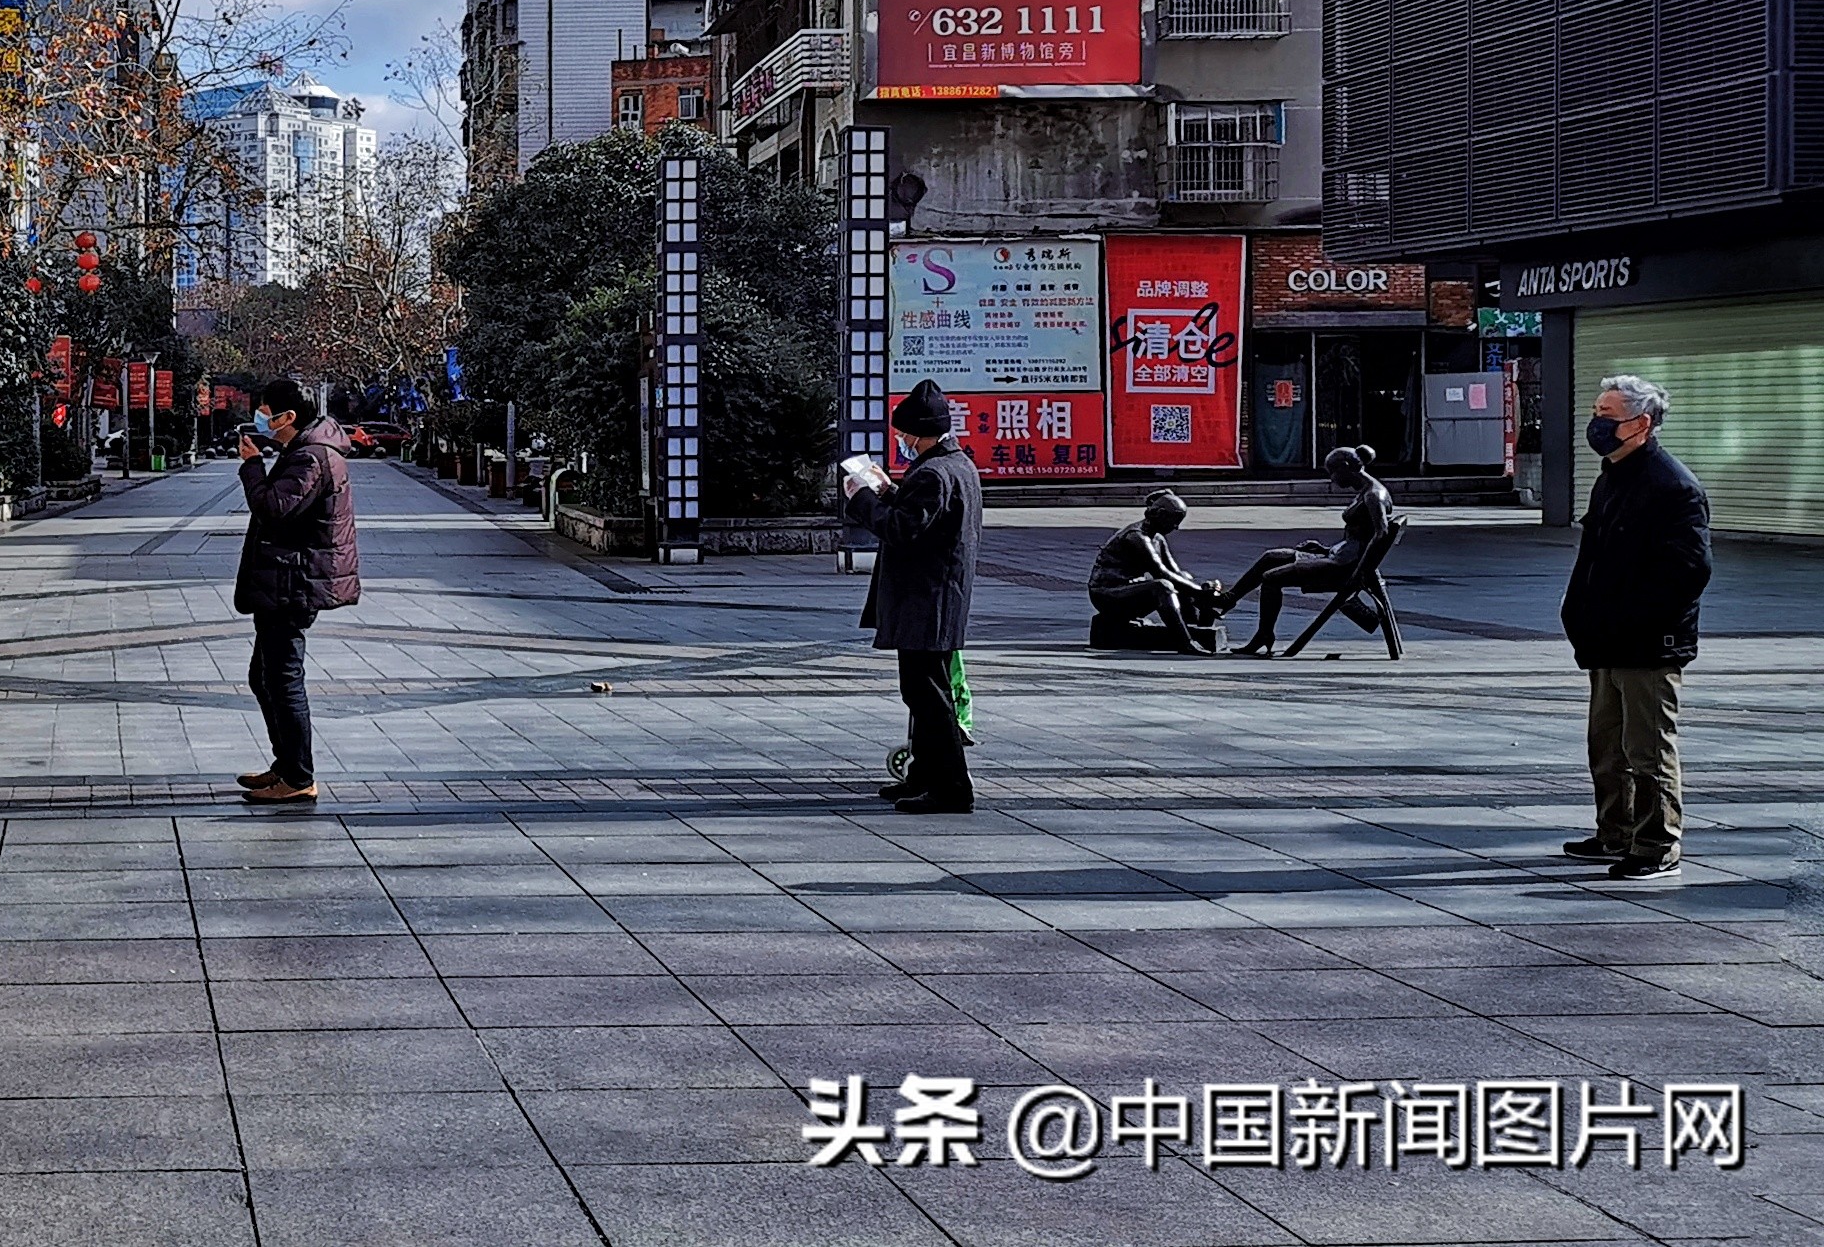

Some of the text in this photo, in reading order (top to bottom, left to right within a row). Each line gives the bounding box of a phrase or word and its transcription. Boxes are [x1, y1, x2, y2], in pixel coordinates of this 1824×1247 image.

[932, 5, 1105, 36] 632 1111
[942, 42, 1075, 61] 宜昌新博物馆旁
[1287, 269, 1388, 292] COLOR
[1517, 257, 1630, 297] ANTA SPORTS
[1136, 280, 1209, 298] 品牌调整
[901, 309, 971, 329] 性感曲线
[1135, 320, 1210, 360] 清仓
[1134, 364, 1208, 383] 全部清空
[995, 397, 1073, 441] 照相
[991, 443, 1097, 466] 车贴 复印
